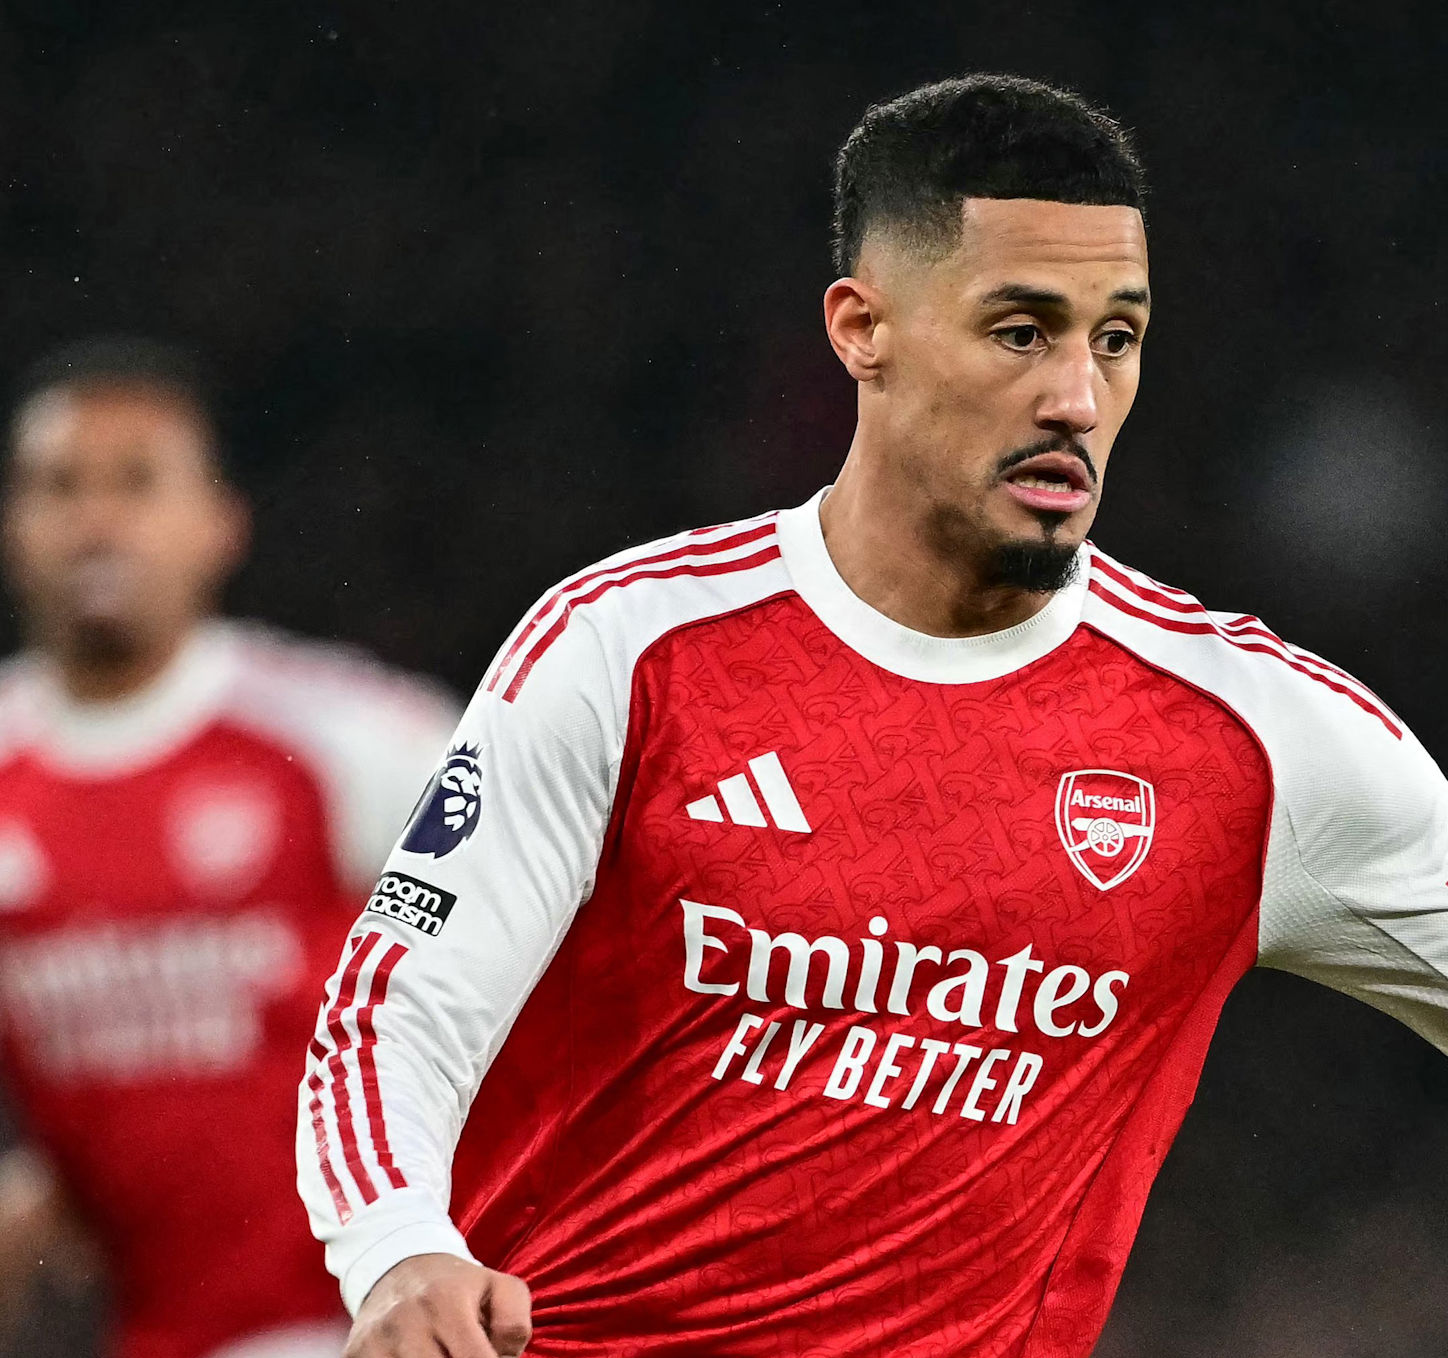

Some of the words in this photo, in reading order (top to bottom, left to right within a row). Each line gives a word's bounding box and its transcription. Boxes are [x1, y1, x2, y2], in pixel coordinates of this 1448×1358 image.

[1071, 789, 1141, 813] Arsenal
[679, 898, 1130, 1038] Emirates
[711, 1013, 825, 1091] FLY
[823, 1026, 1043, 1126] BETTER
